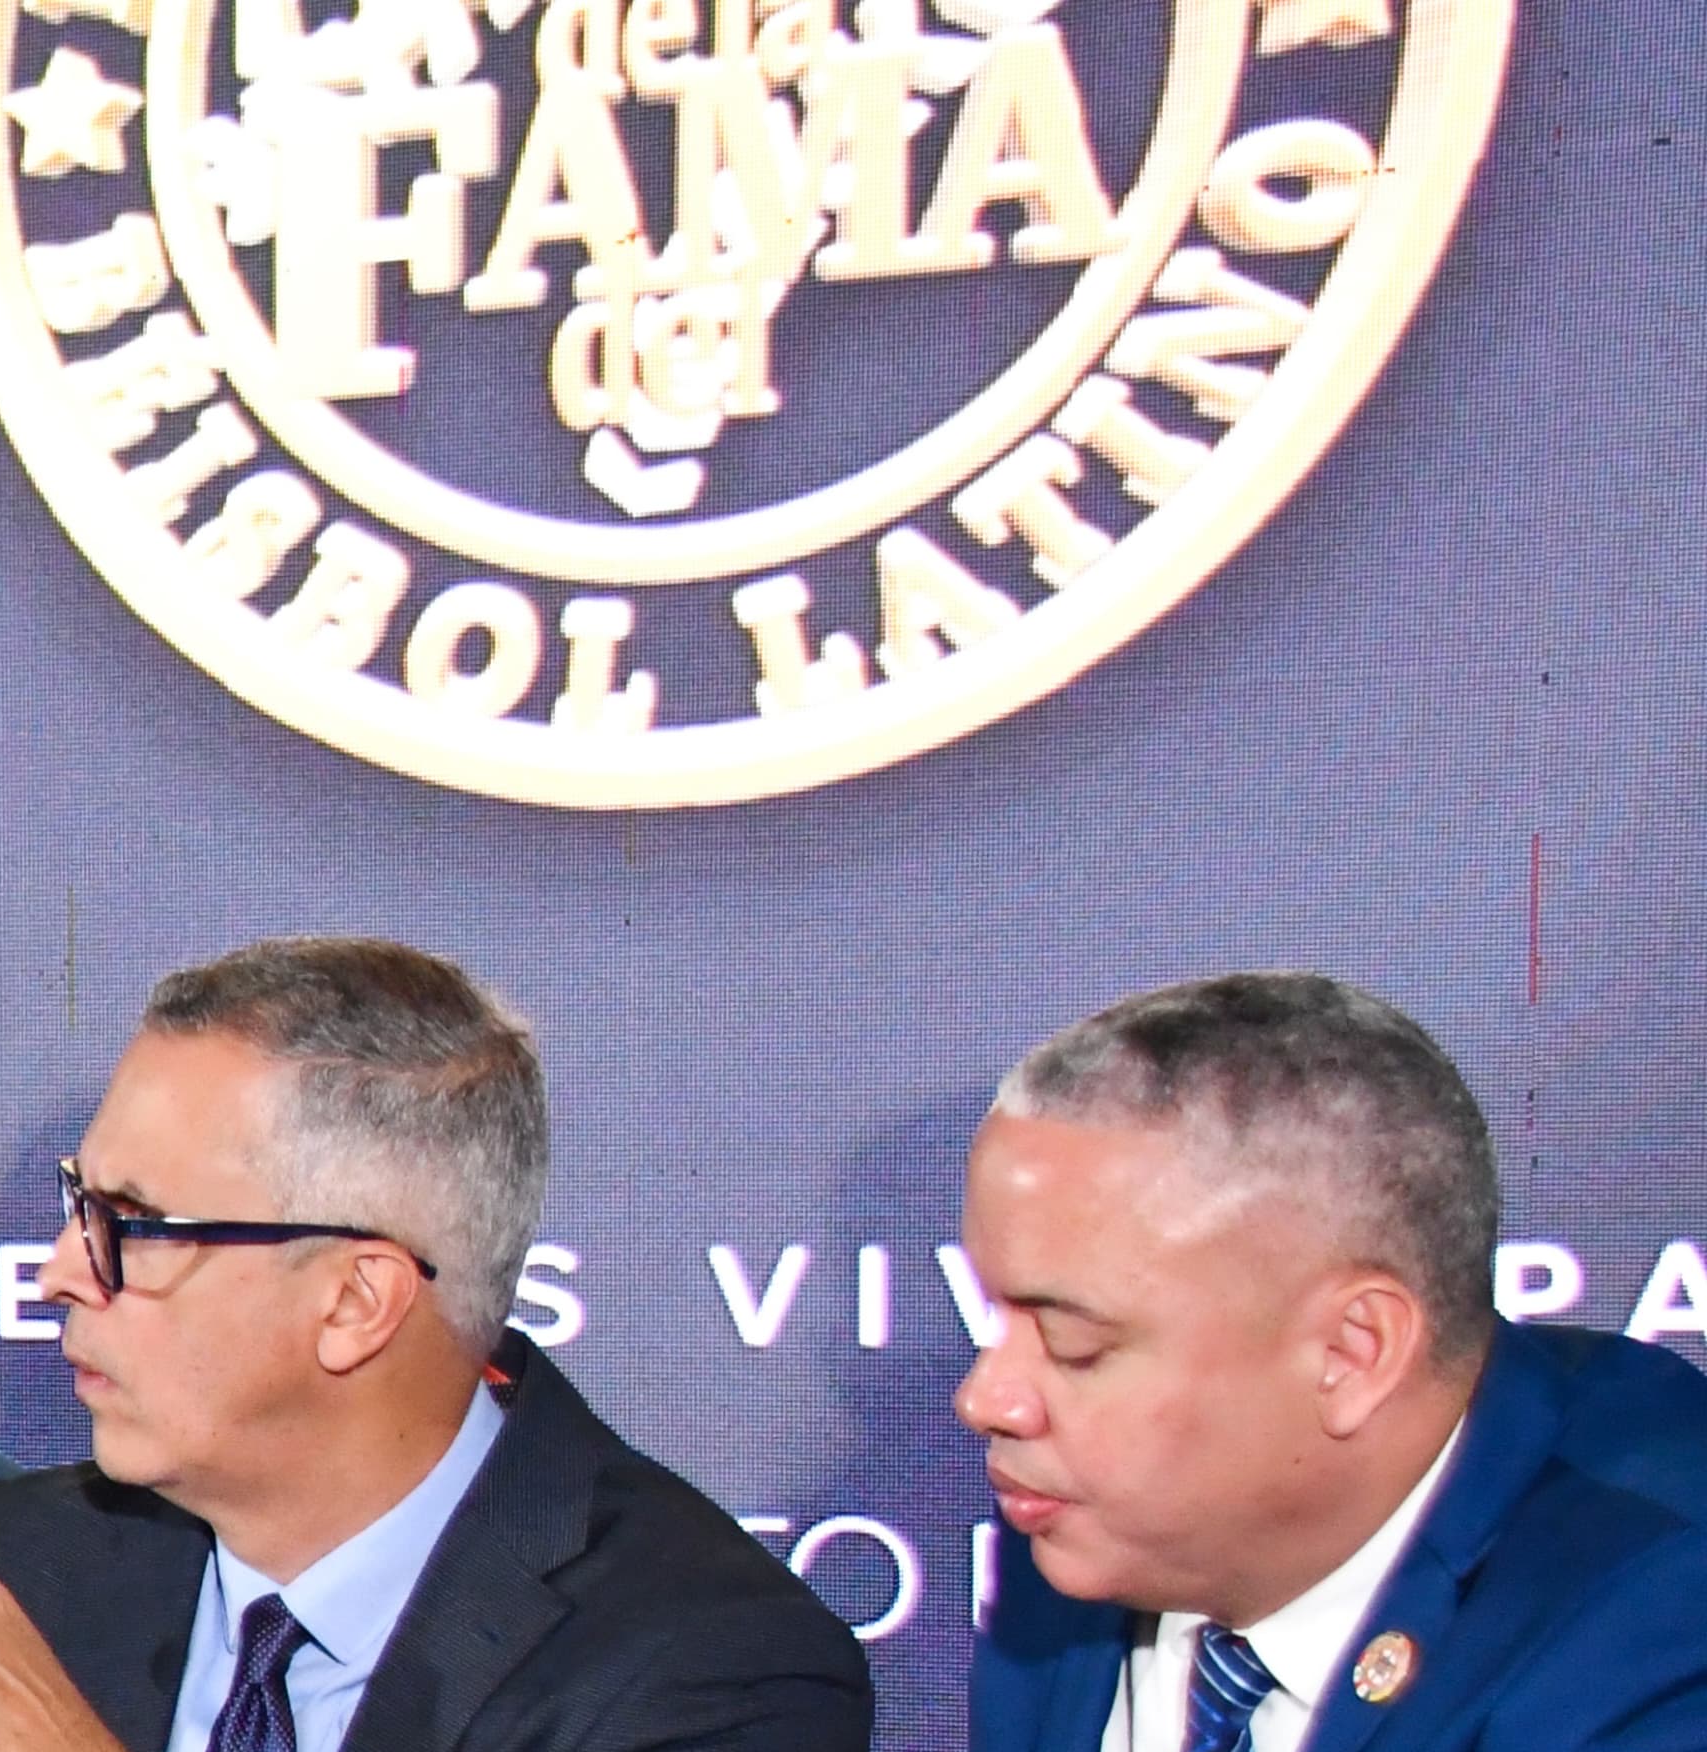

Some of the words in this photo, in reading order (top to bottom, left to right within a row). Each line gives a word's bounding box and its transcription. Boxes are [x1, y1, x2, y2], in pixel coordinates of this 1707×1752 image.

[23, 213, 655, 735] BEISBOL
[733, 118, 1379, 718] LATINO
[242, 20, 1127, 399] FAMA
